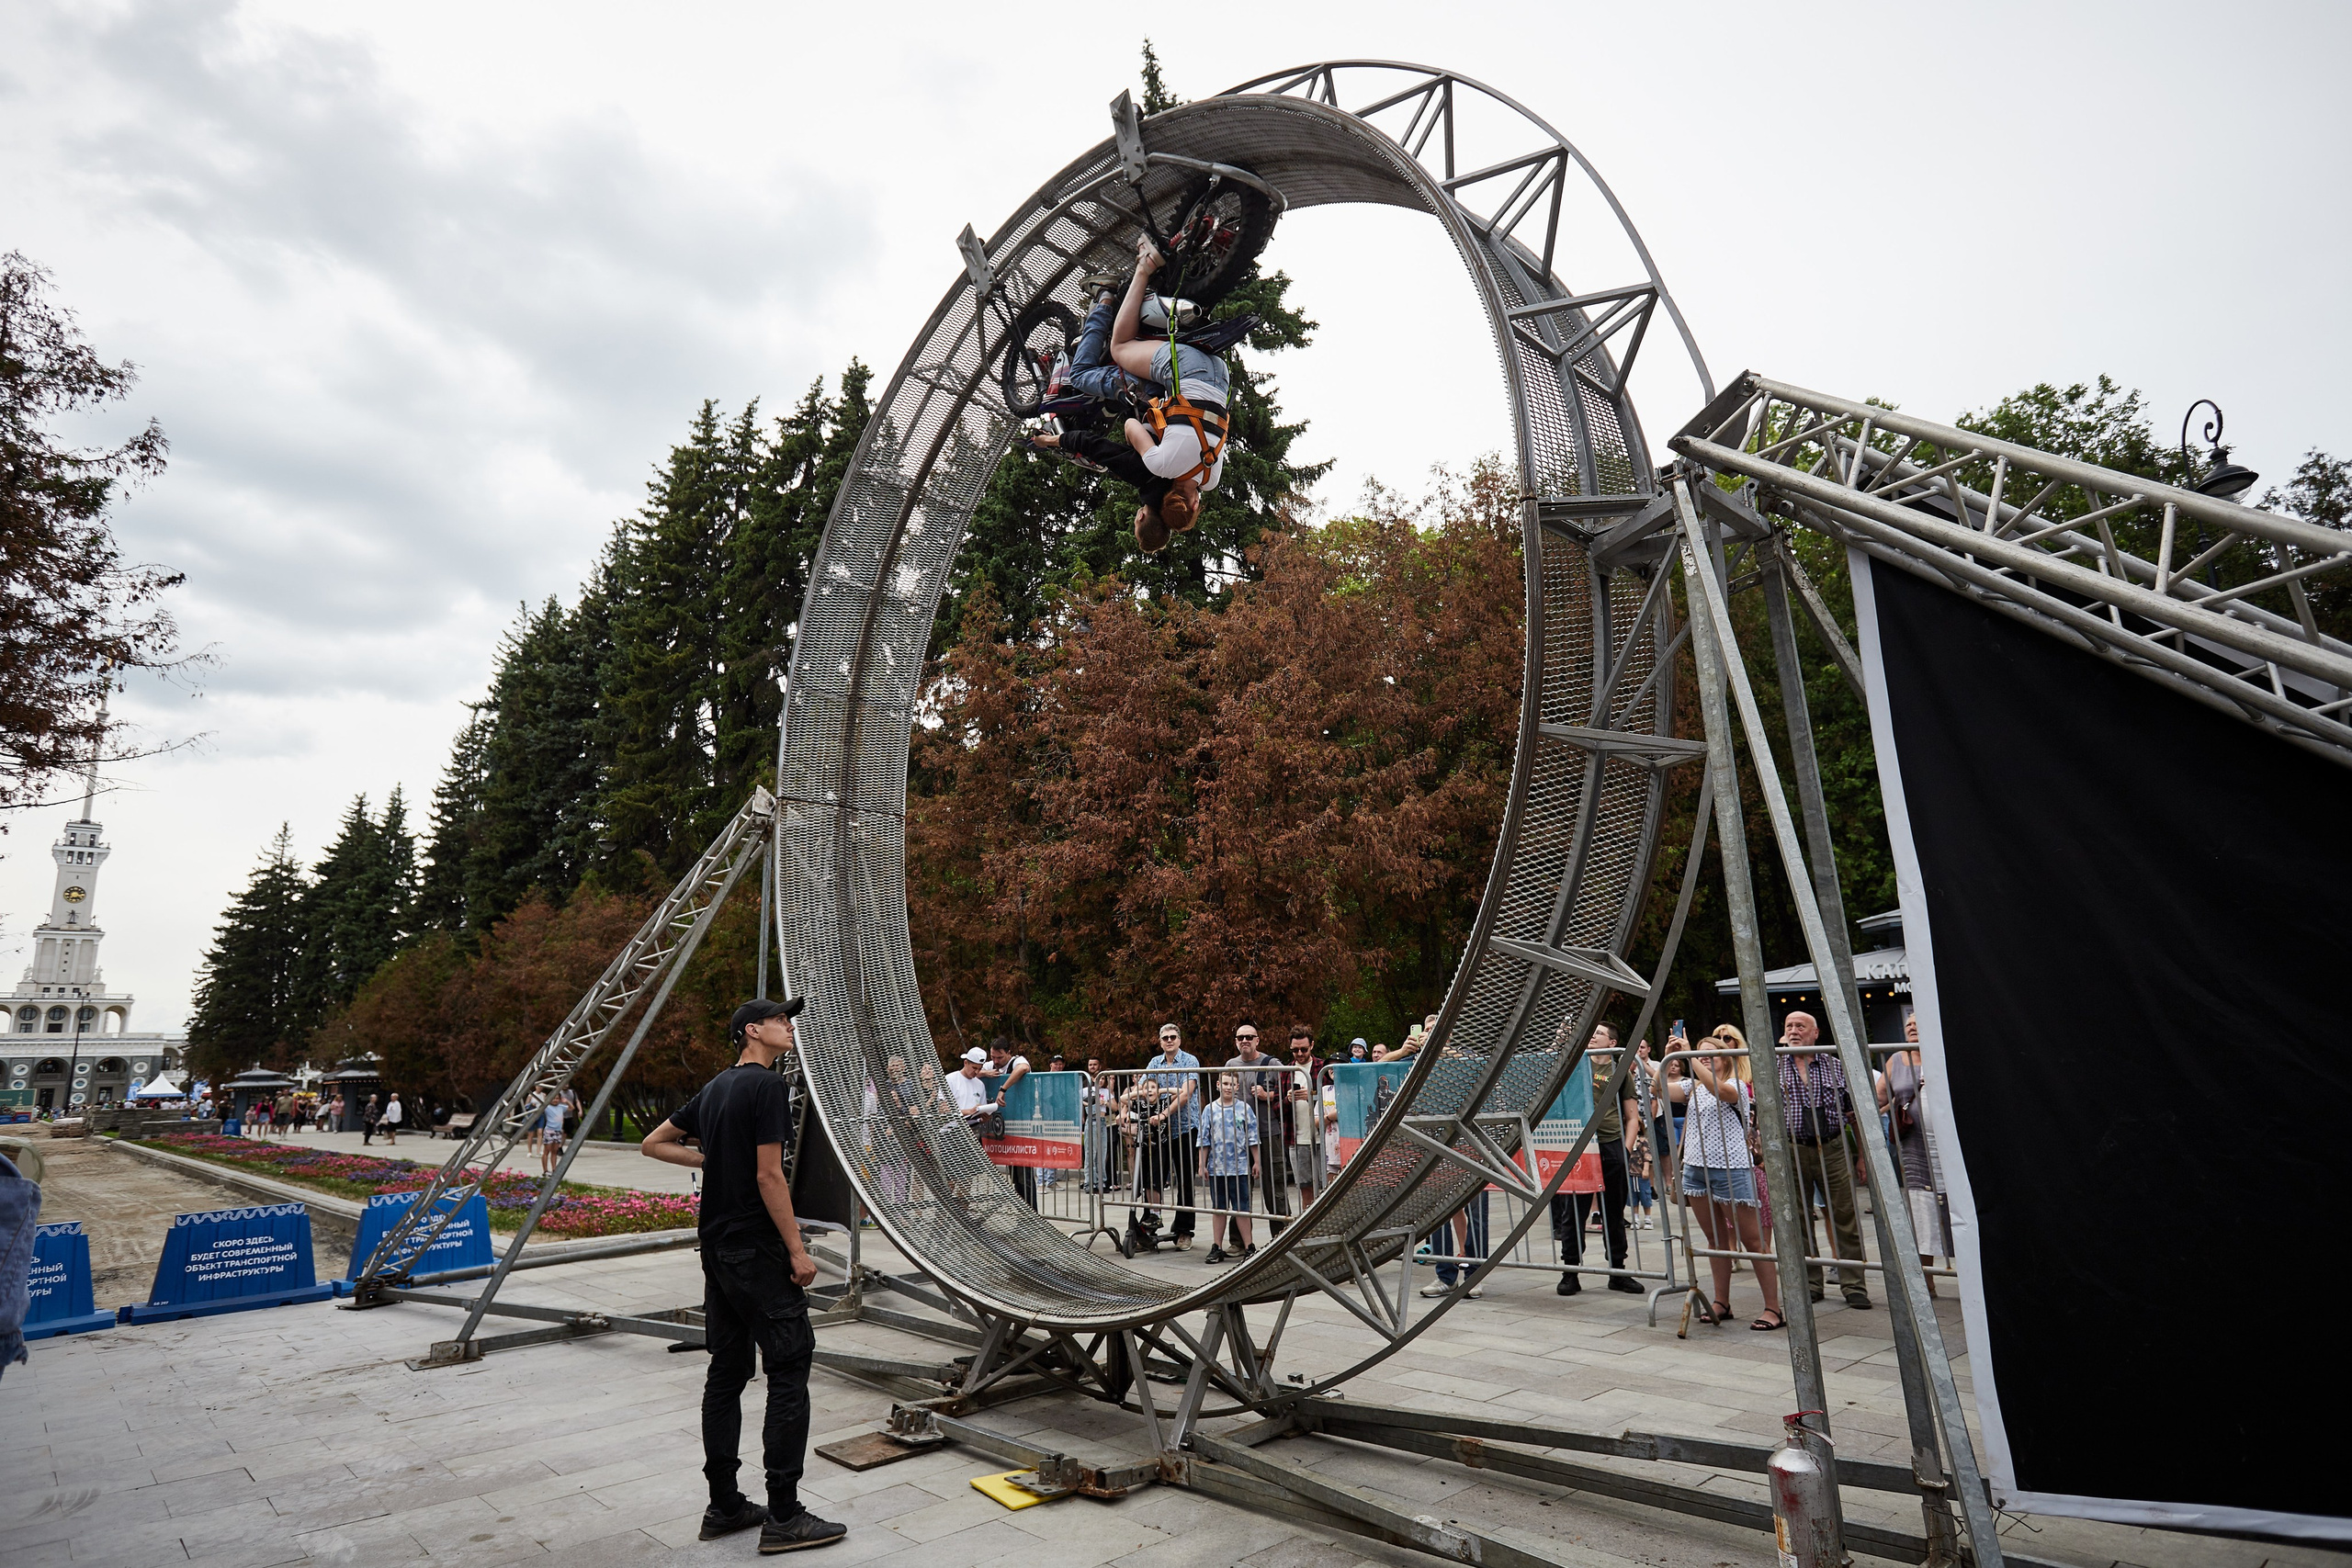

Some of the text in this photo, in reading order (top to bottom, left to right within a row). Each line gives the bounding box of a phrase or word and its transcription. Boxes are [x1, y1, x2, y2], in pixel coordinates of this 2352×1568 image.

[212, 1235, 275, 1248] СКОРО ЗДЕСЬ
[190, 1242, 294, 1262] БУДЕТ СОВРЕМЕННЫЙ
[185, 1251, 298, 1273] ОБЪЕКТ ТРАНСПОРТНОЙ
[198, 1265, 284, 1282] ИНФРАСТРУКТУРЫ
